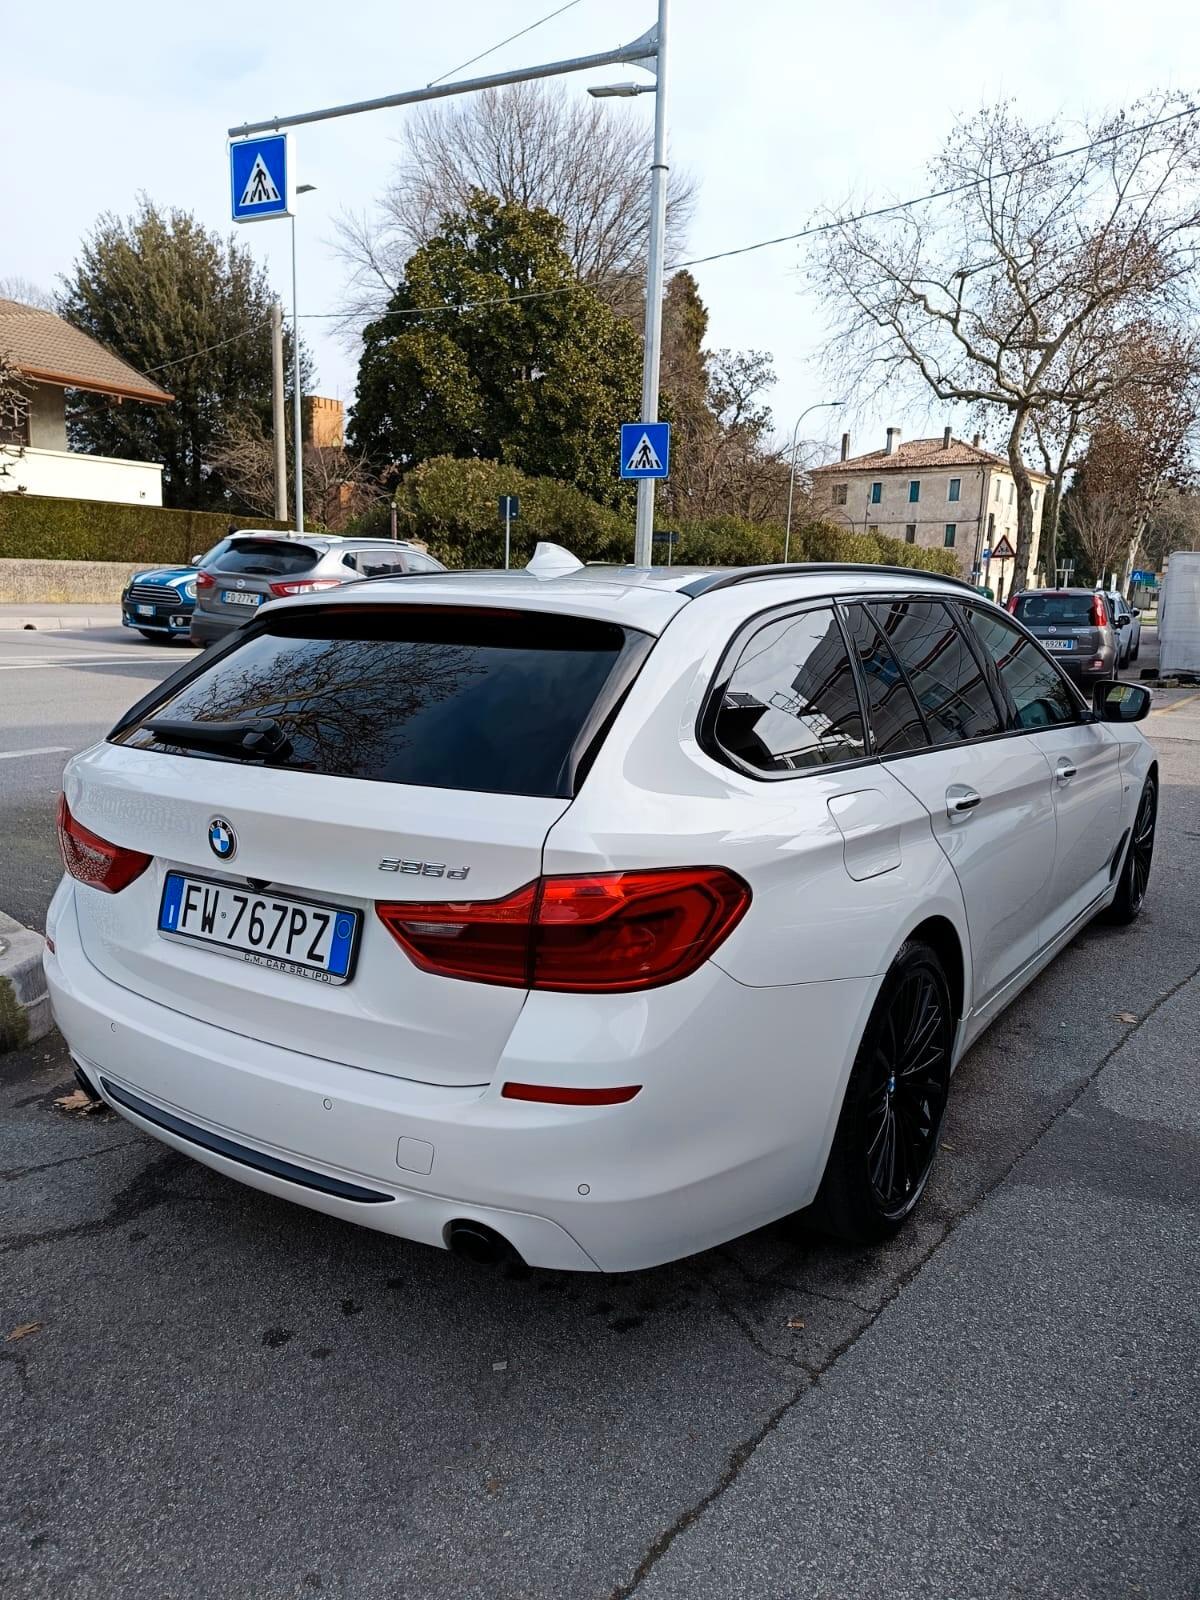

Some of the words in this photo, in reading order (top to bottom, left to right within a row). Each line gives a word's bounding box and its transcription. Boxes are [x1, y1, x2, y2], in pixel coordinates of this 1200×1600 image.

[244, 953, 263, 967] C.M.
[266, 959, 287, 972] CAR
[289, 965, 309, 977] SRL
